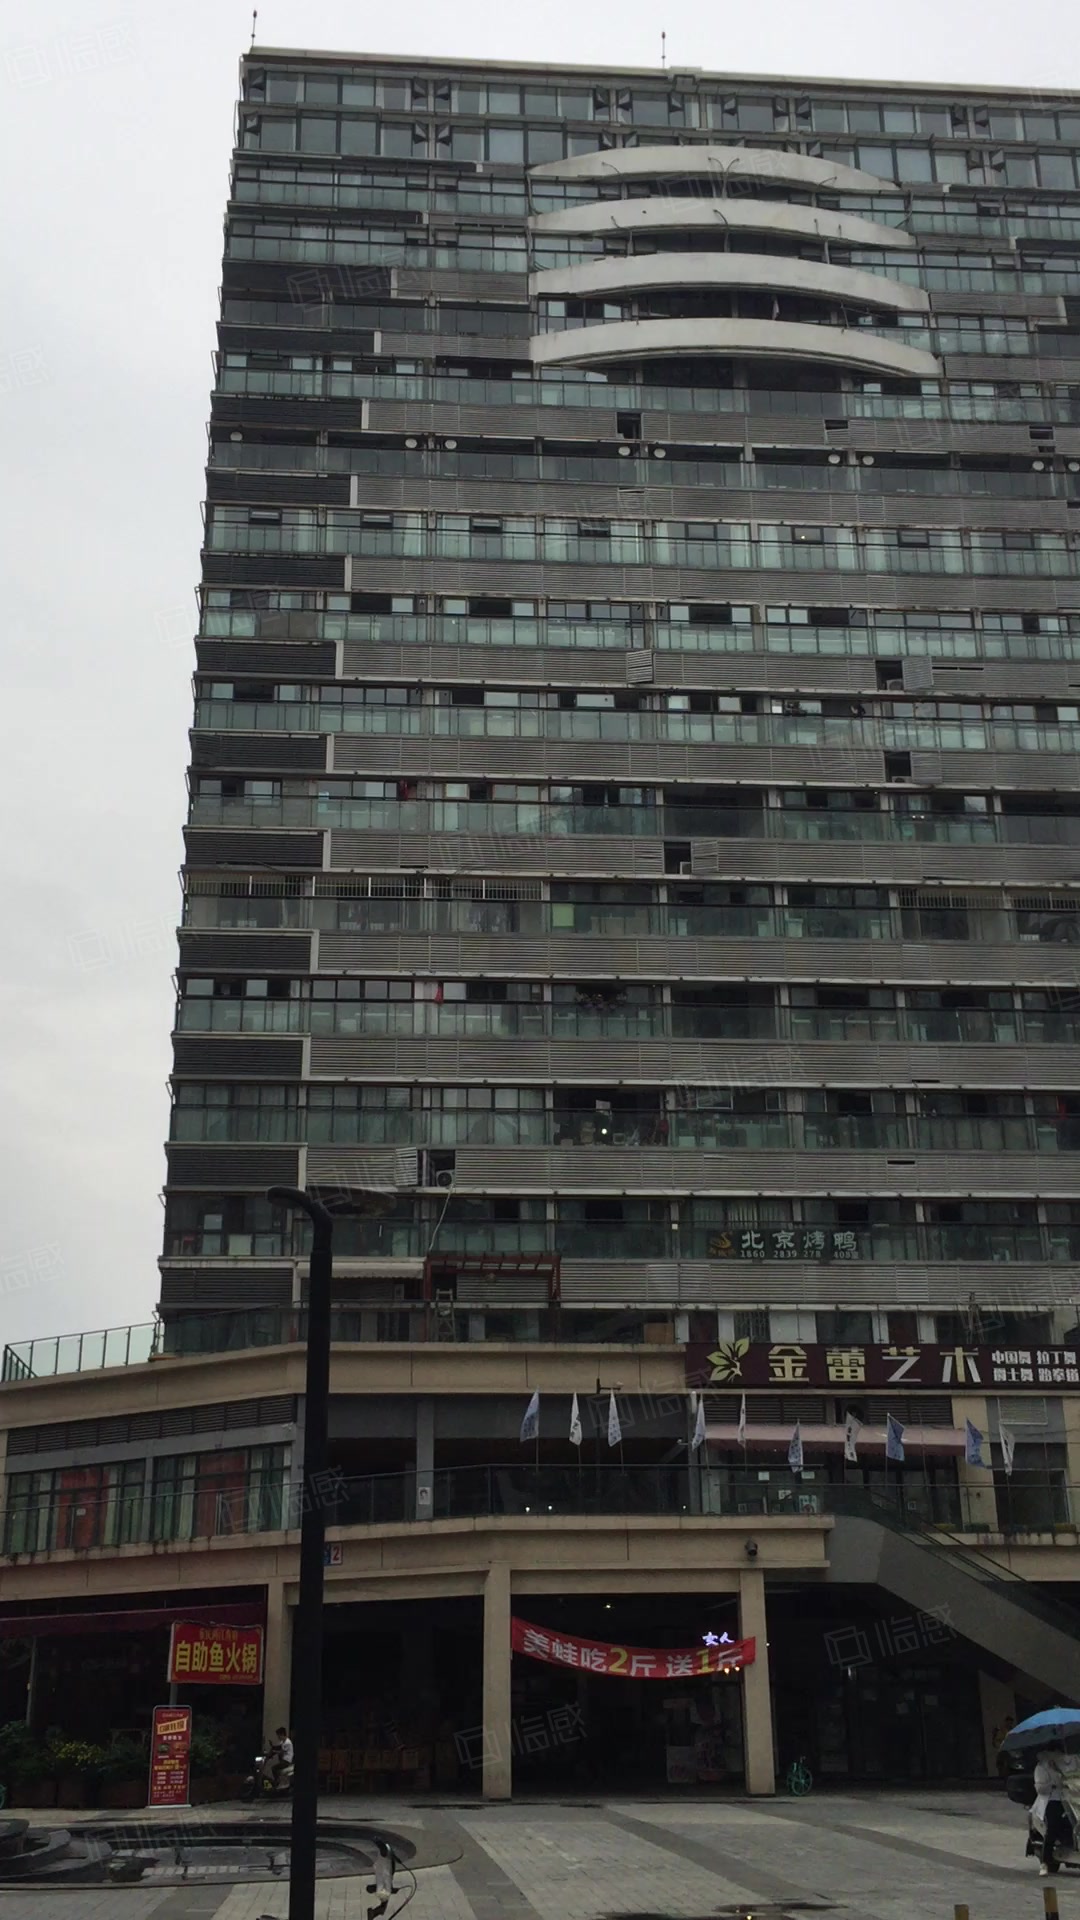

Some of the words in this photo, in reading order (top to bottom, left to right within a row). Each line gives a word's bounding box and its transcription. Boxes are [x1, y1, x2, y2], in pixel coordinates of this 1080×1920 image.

[741, 1230, 858, 1250] 北京烤鸭
[768, 1345, 982, 1383] 金蕾艺术
[991, 1350, 1032, 1365] 中国舞
[1037, 1350, 1077, 1365] 拉丁舞
[331, 1545, 341, 1561] 2
[175, 1640, 257, 1673] 自助鱼火锅
[523, 1629, 657, 1677] 美蛙吃2斤
[665, 1647, 744, 1677] 送1斤
